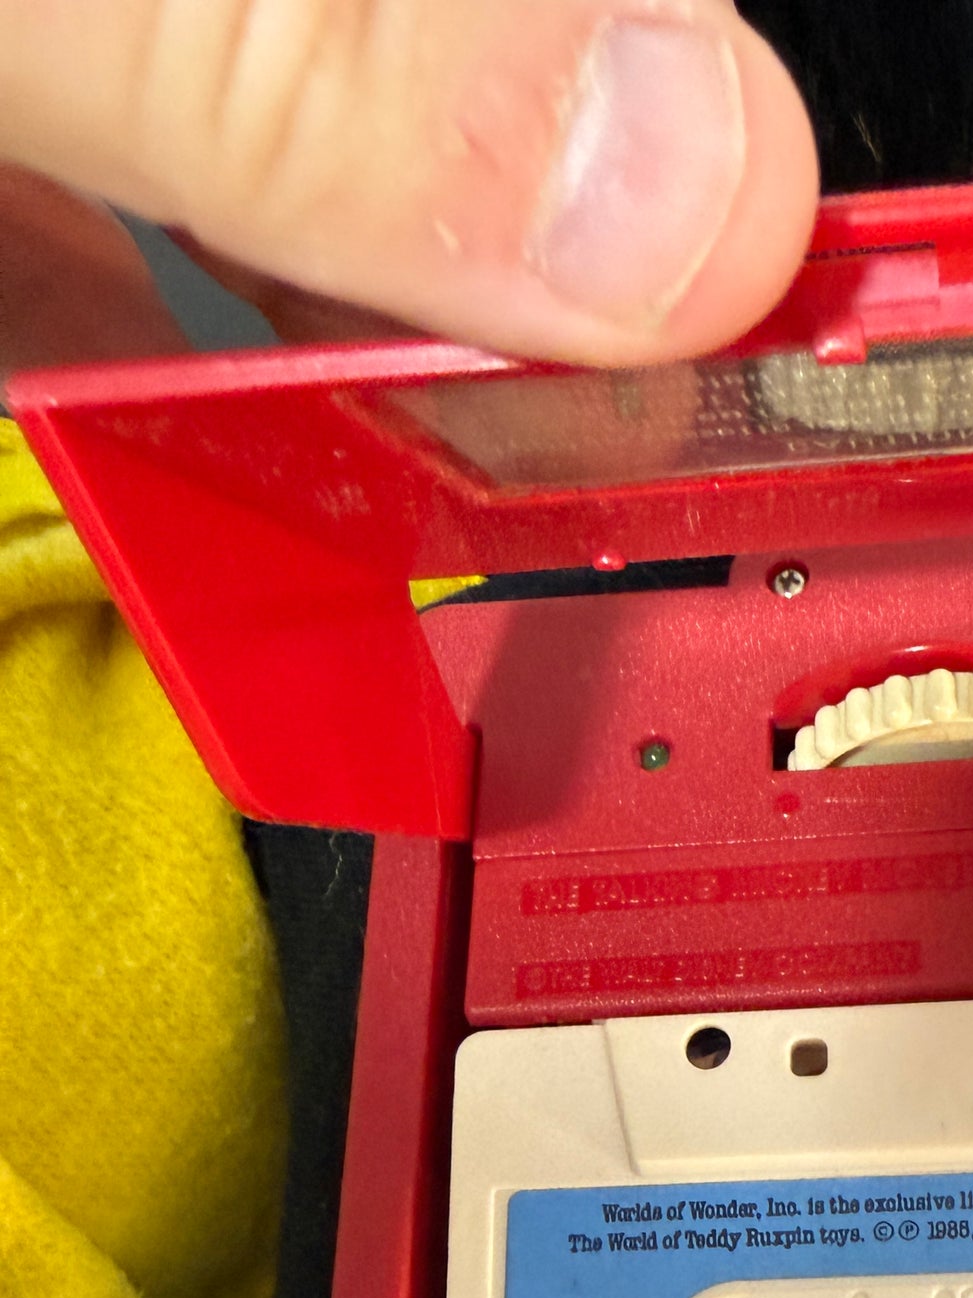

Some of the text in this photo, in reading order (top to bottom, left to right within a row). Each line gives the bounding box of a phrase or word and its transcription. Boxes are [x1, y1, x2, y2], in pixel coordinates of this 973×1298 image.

[602, 1202, 662, 1223] Worlds
[667, 1201, 686, 1221] of
[689, 1200, 761, 1220] Wonder,
[766, 1198, 801, 1217] Inc.
[808, 1198, 824, 1215] is
[829, 1195, 860, 1214] the
[864, 1192, 955, 1213] exclusive
[568, 1234, 602, 1253] The
[608, 1231, 658, 1251] World
[662, 1230, 681, 1249] of
[685, 1229, 741, 1252] Teddy
[746, 1226, 815, 1249] Ruxpin
[819, 1228, 864, 1247] toys.
